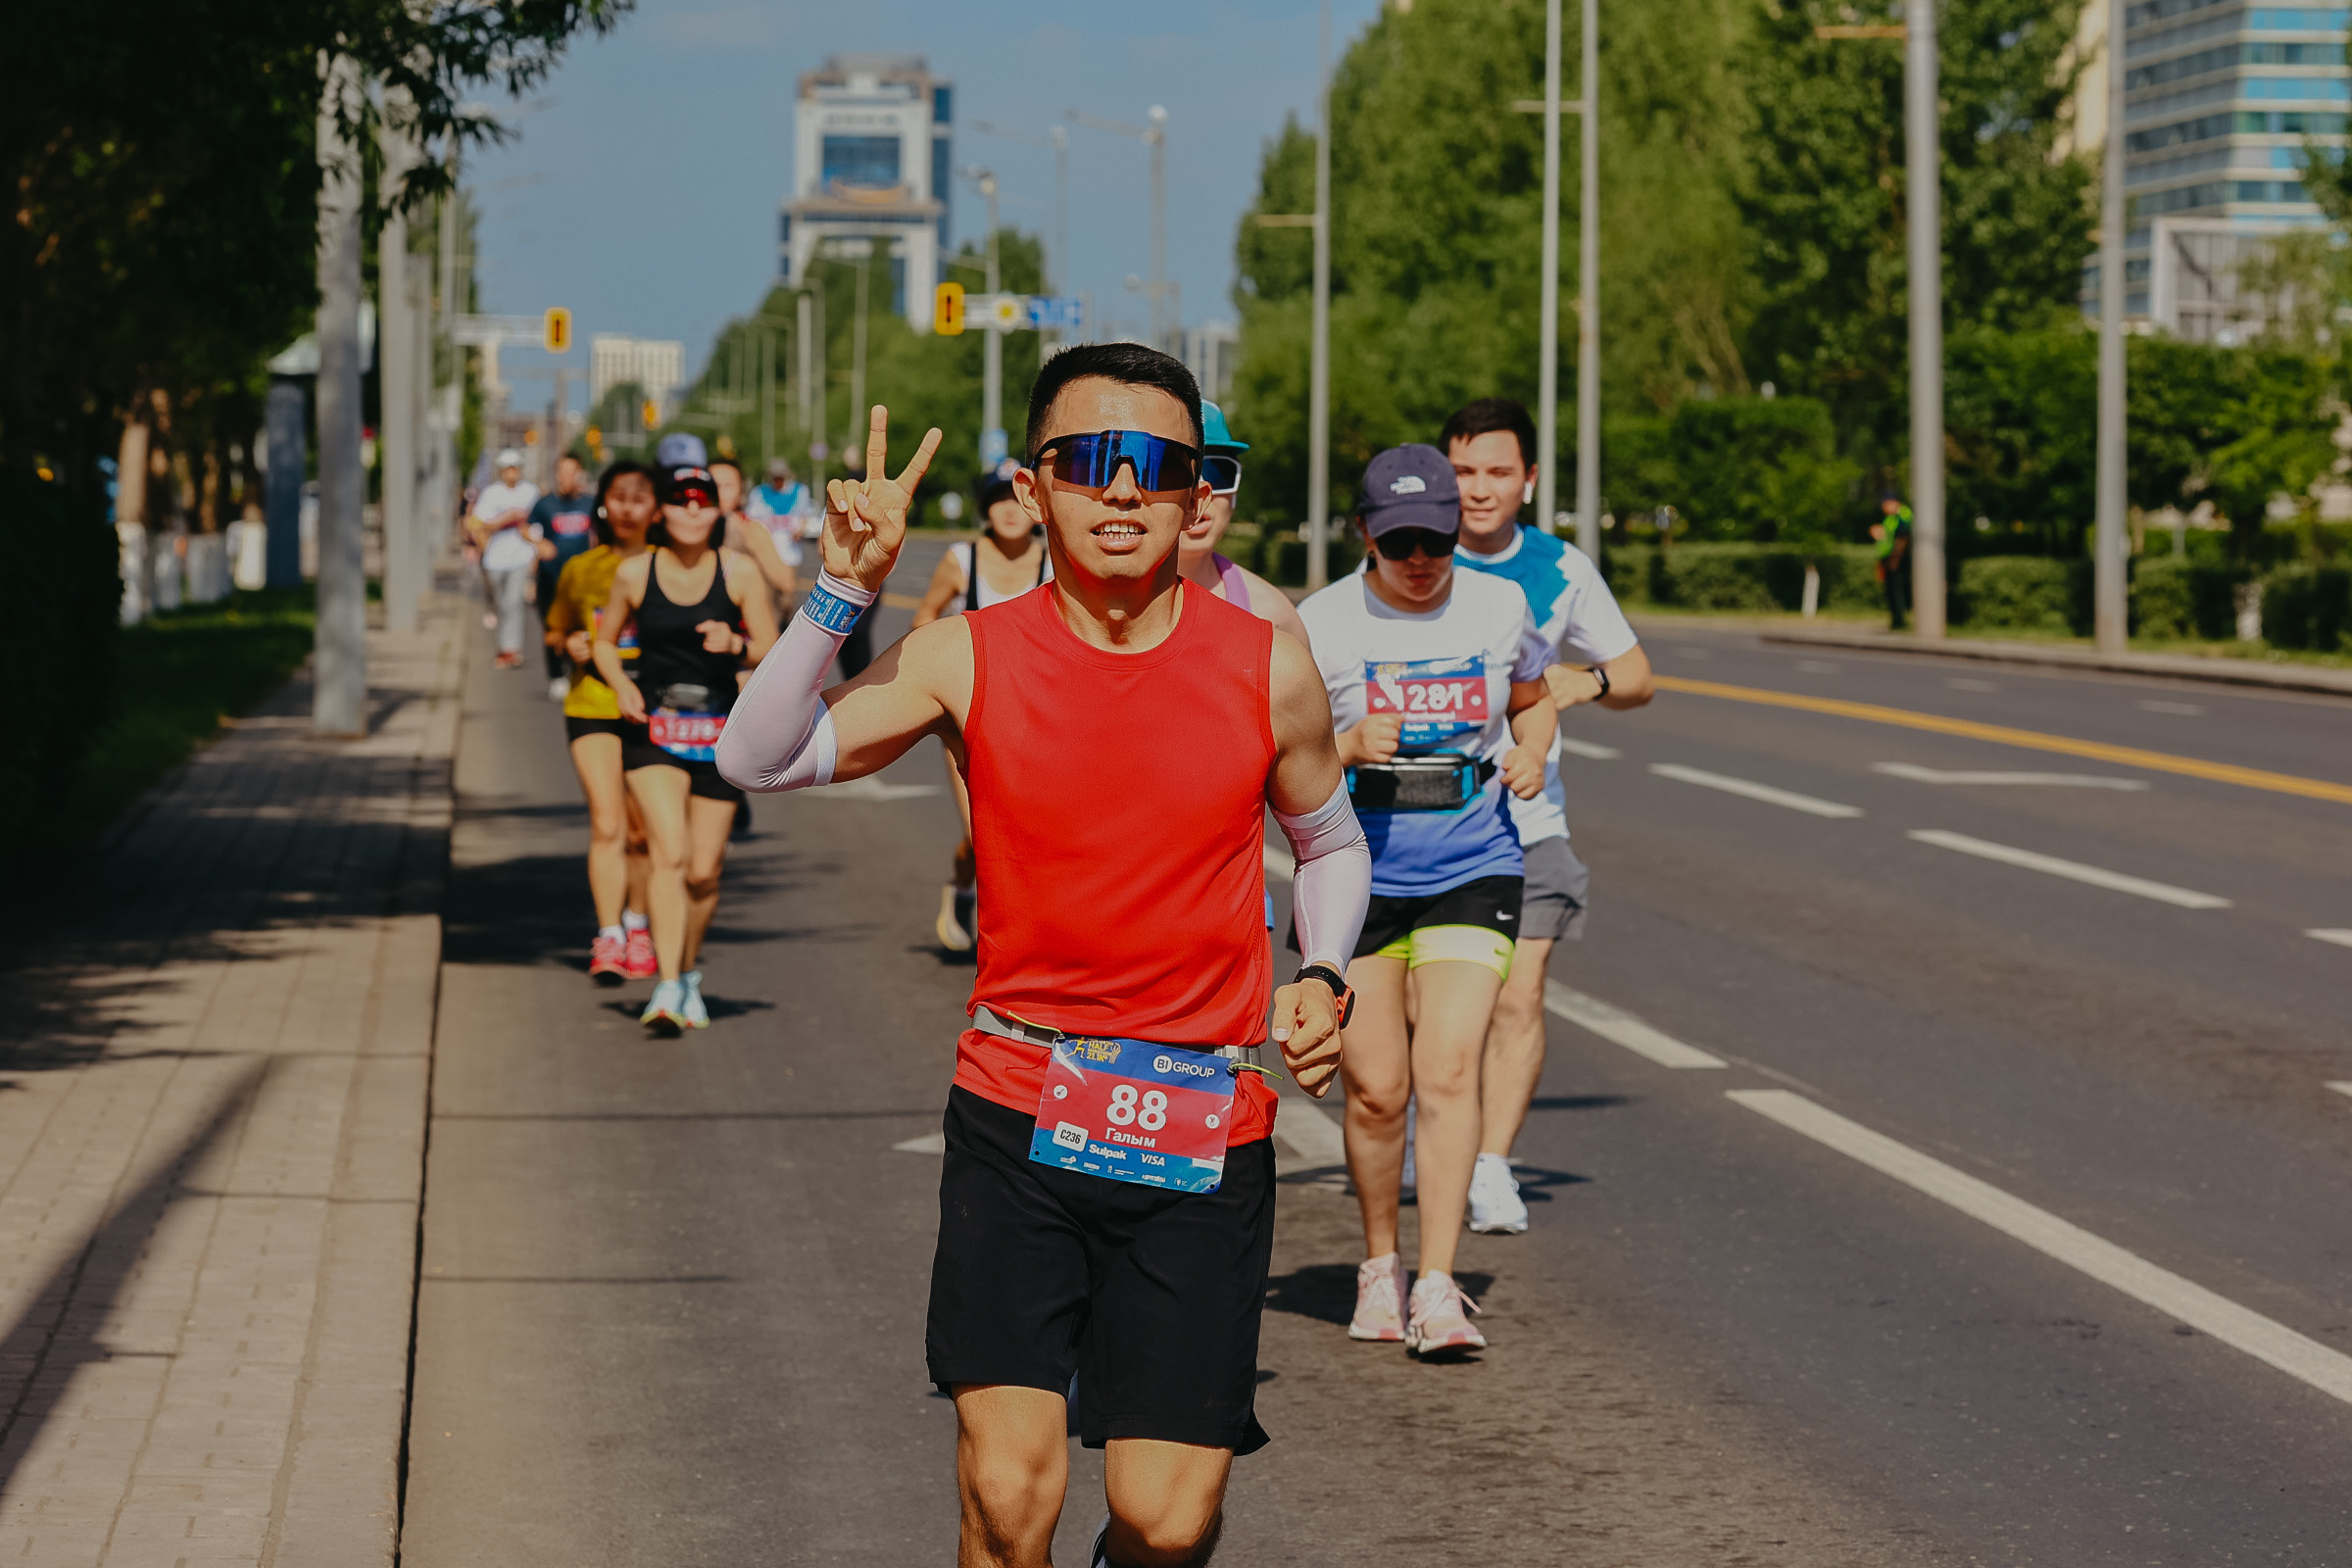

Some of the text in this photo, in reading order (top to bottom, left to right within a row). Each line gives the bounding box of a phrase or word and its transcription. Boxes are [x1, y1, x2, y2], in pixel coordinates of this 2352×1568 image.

[1088, 1041, 1109, 1052] HALF
[1157, 1058, 1215, 1078] BI GROUP
[1106, 1084, 1168, 1131] 88
[1060, 1129, 1082, 1145] C236
[1104, 1127, 1156, 1148] Галым
[1089, 1144, 1166, 1167] Sulpak VISA
